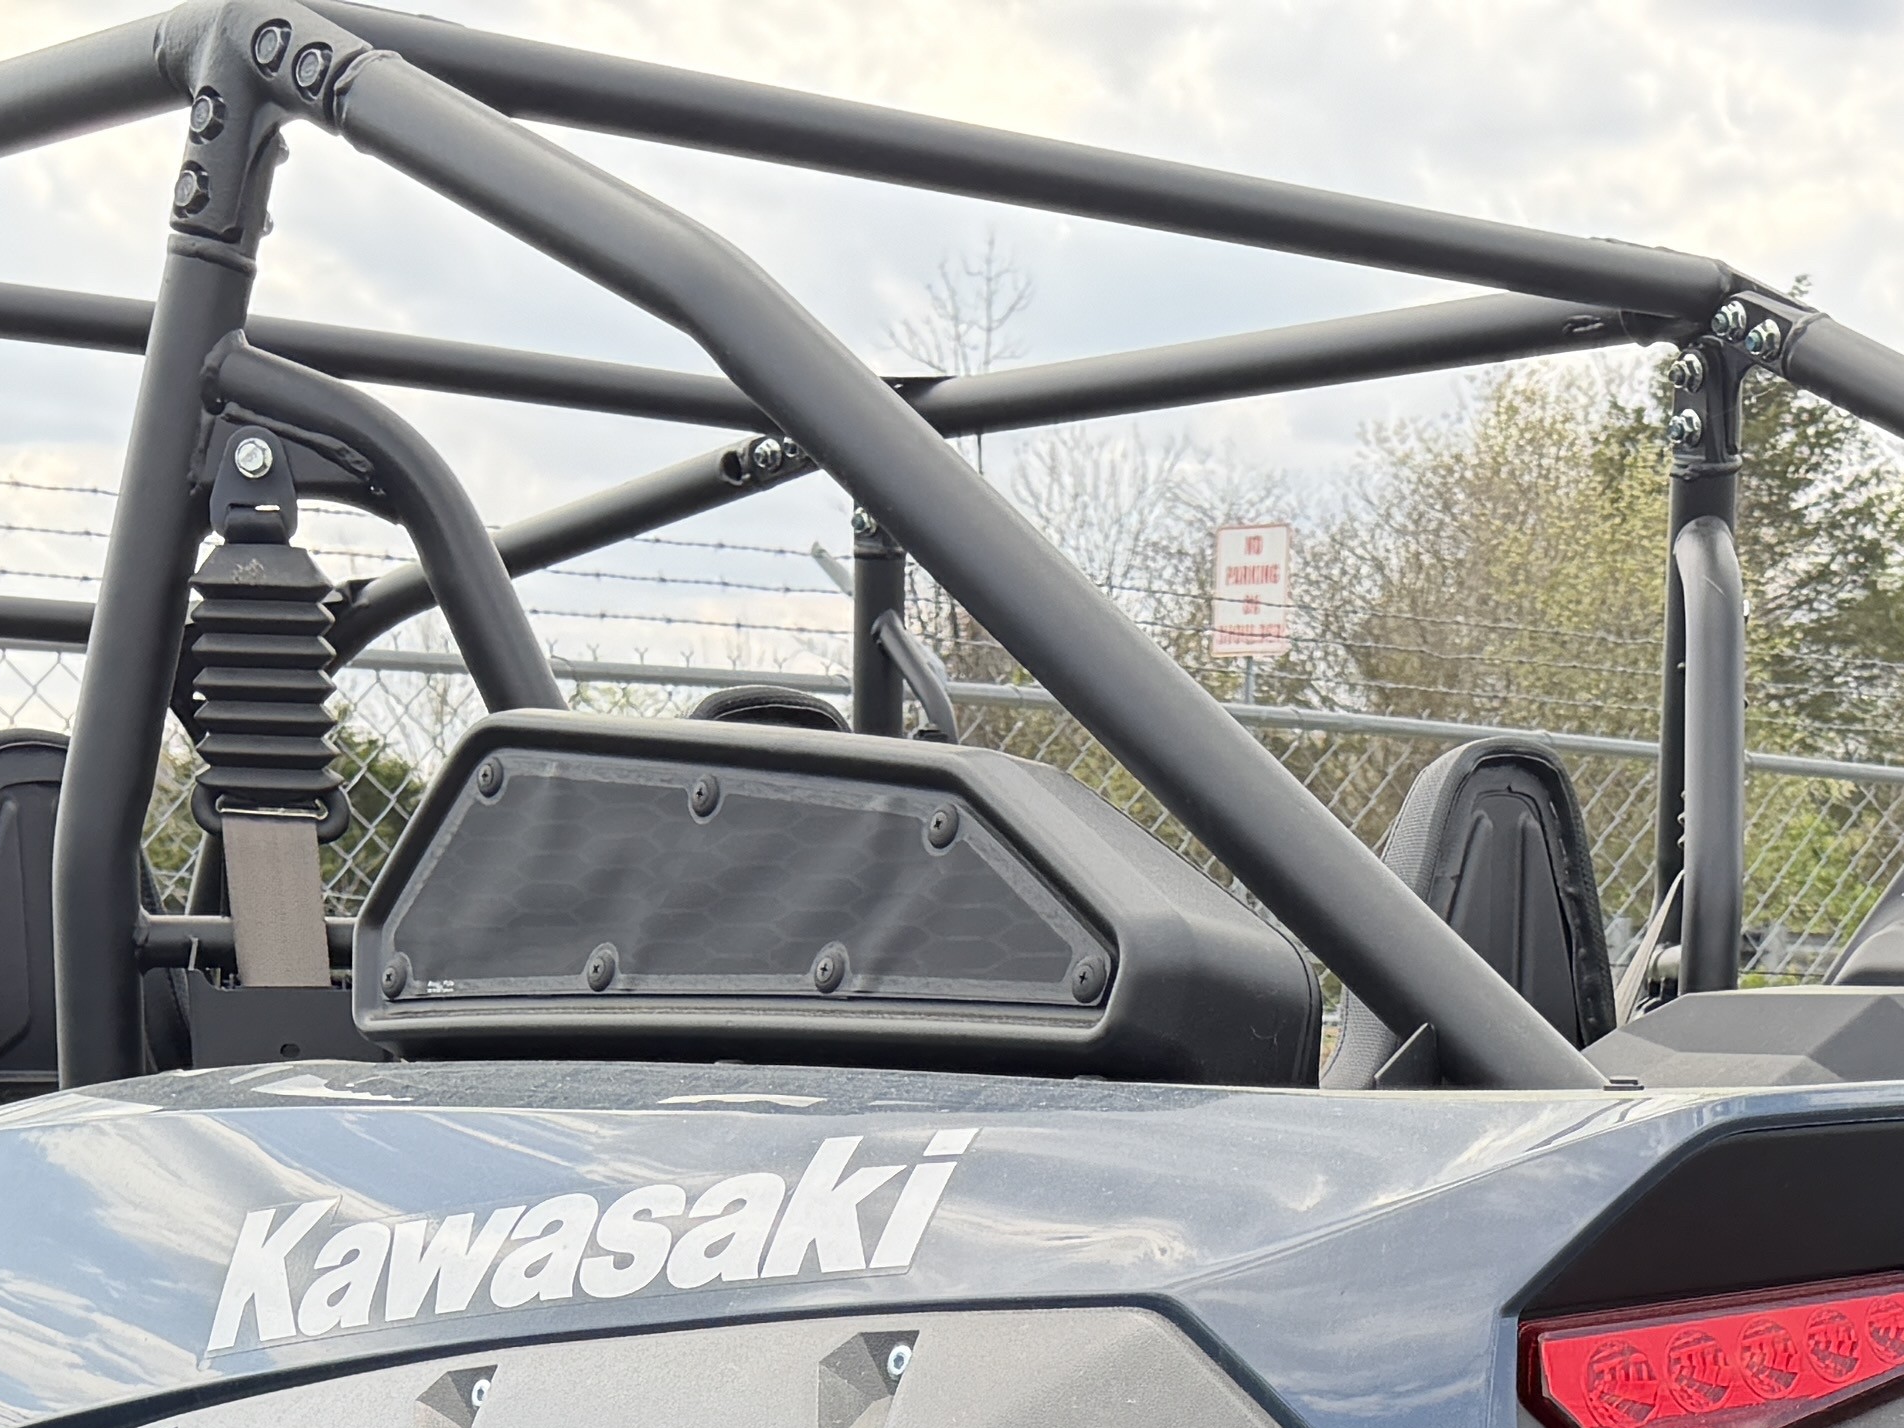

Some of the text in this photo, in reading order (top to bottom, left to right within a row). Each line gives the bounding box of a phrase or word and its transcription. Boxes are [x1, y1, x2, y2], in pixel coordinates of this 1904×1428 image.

[1245, 535, 1264, 555] NO
[1225, 564, 1281, 586] PARKING
[206, 1127, 981, 1353] Kawasaki
